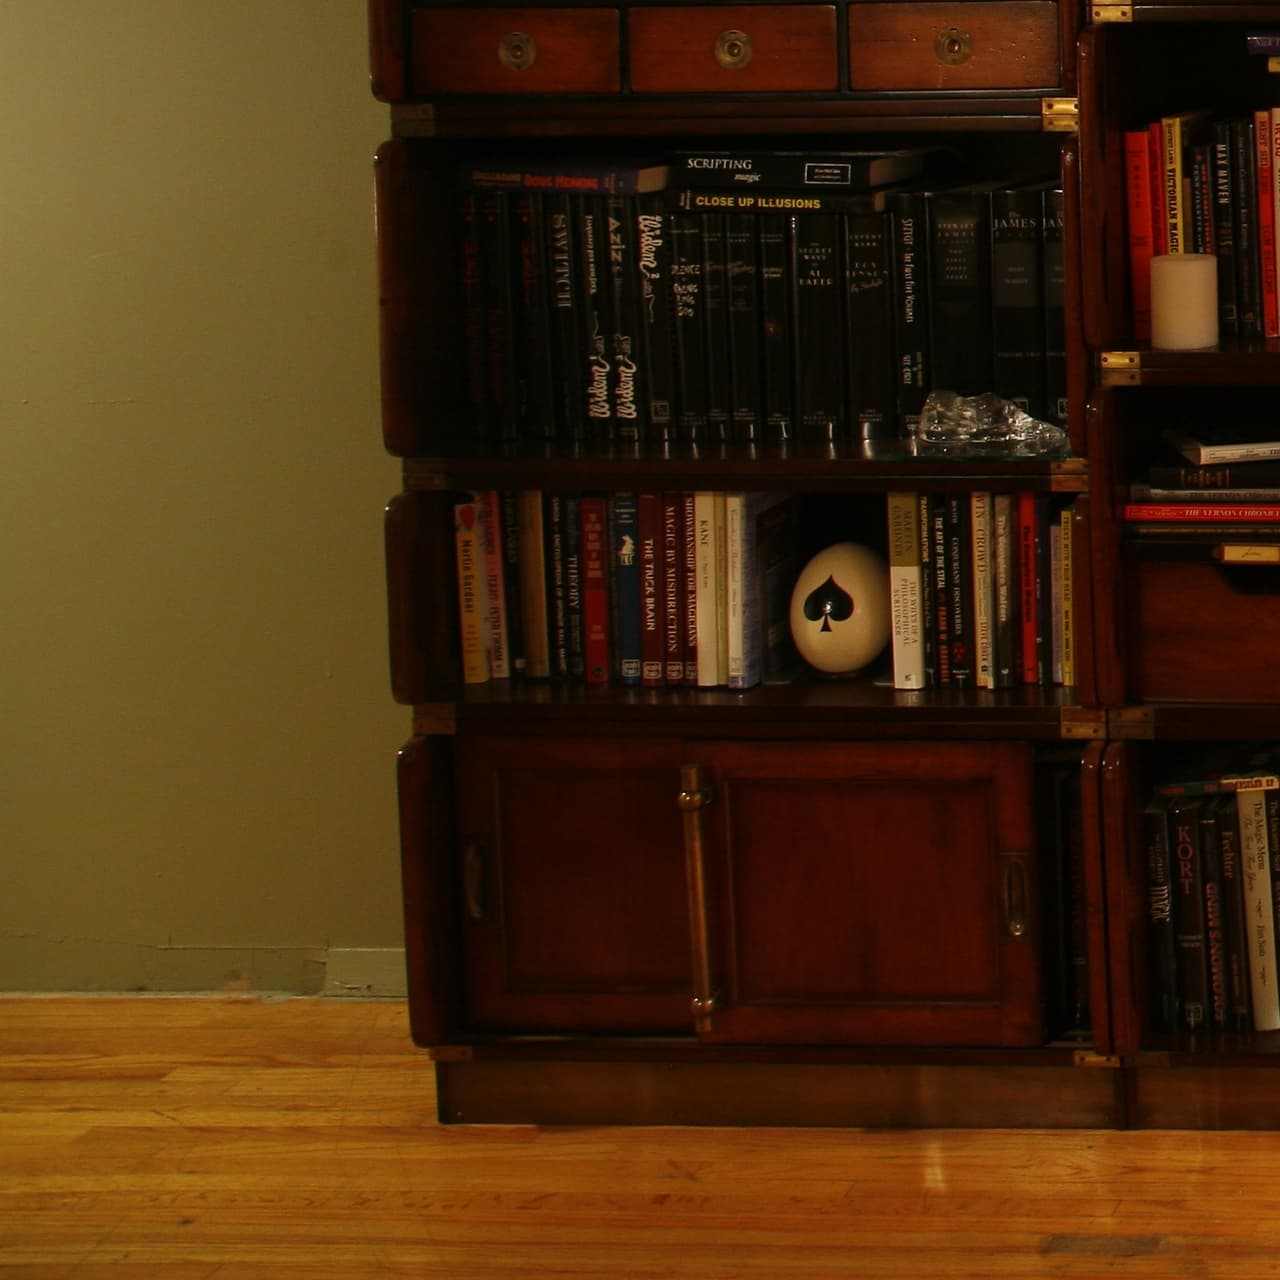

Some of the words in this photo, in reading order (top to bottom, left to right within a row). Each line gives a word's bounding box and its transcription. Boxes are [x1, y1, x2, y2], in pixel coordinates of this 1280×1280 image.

[688, 159, 753, 171] SCRIPTING
[1216, 145, 1229, 166] MAX
[1168, 168, 1178, 219] VICTORIAN
[1216, 170, 1229, 204] MAVEN
[696, 196, 735, 210] CLOSE
[738, 196, 755, 210] UP
[758, 196, 821, 210] ILLUSIONS
[1168, 223, 1178, 253] MAGIC
[665, 505, 678, 545] MAGIC
[685, 497, 697, 568] SHOWMANSHIP
[643, 539, 655, 559] THE
[666, 549, 679, 564] BY
[568, 554, 580, 608] THEORY
[644, 563, 656, 594] TRICK
[685, 572, 697, 591] FOR
[644, 597, 656, 631] BRAIN
[667, 568, 680, 652] MISDIRECTION
[685, 595, 697, 646] MAGICIANS
[1255, 801, 1266, 815] The
[1255, 818, 1266, 844] Magic
[1178, 827, 1193, 894] KORT
[1255, 847, 1266, 870] Menu
